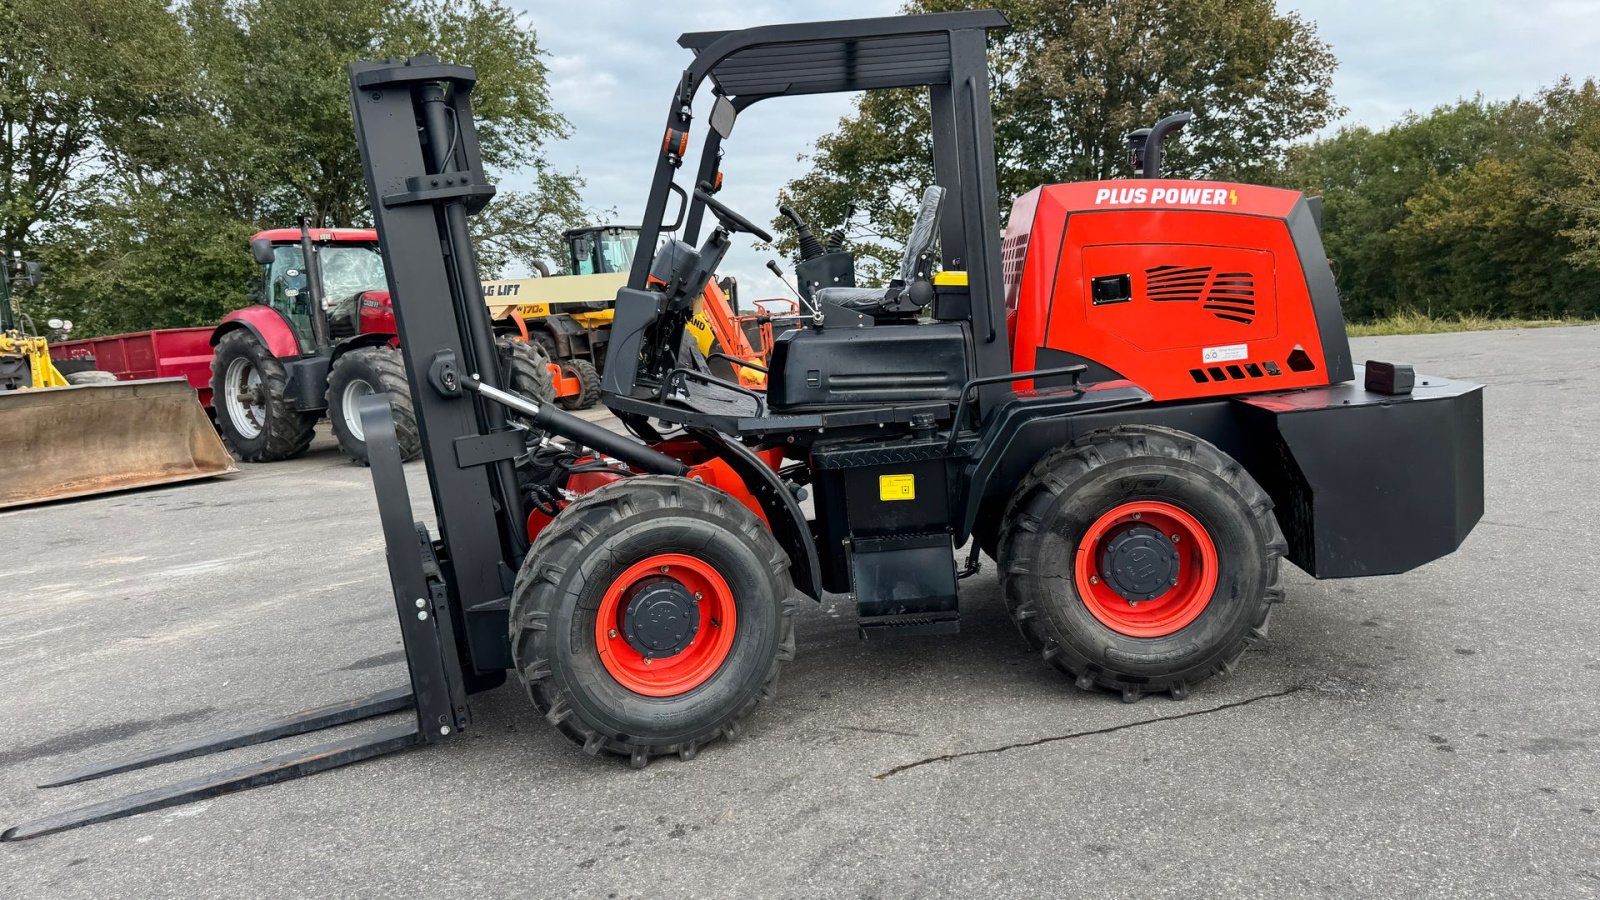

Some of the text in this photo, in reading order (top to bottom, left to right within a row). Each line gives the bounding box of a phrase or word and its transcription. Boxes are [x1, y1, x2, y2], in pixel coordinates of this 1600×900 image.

[1095, 188, 1228, 205] PLUS POWER
[497, 284, 520, 296] LIFT
